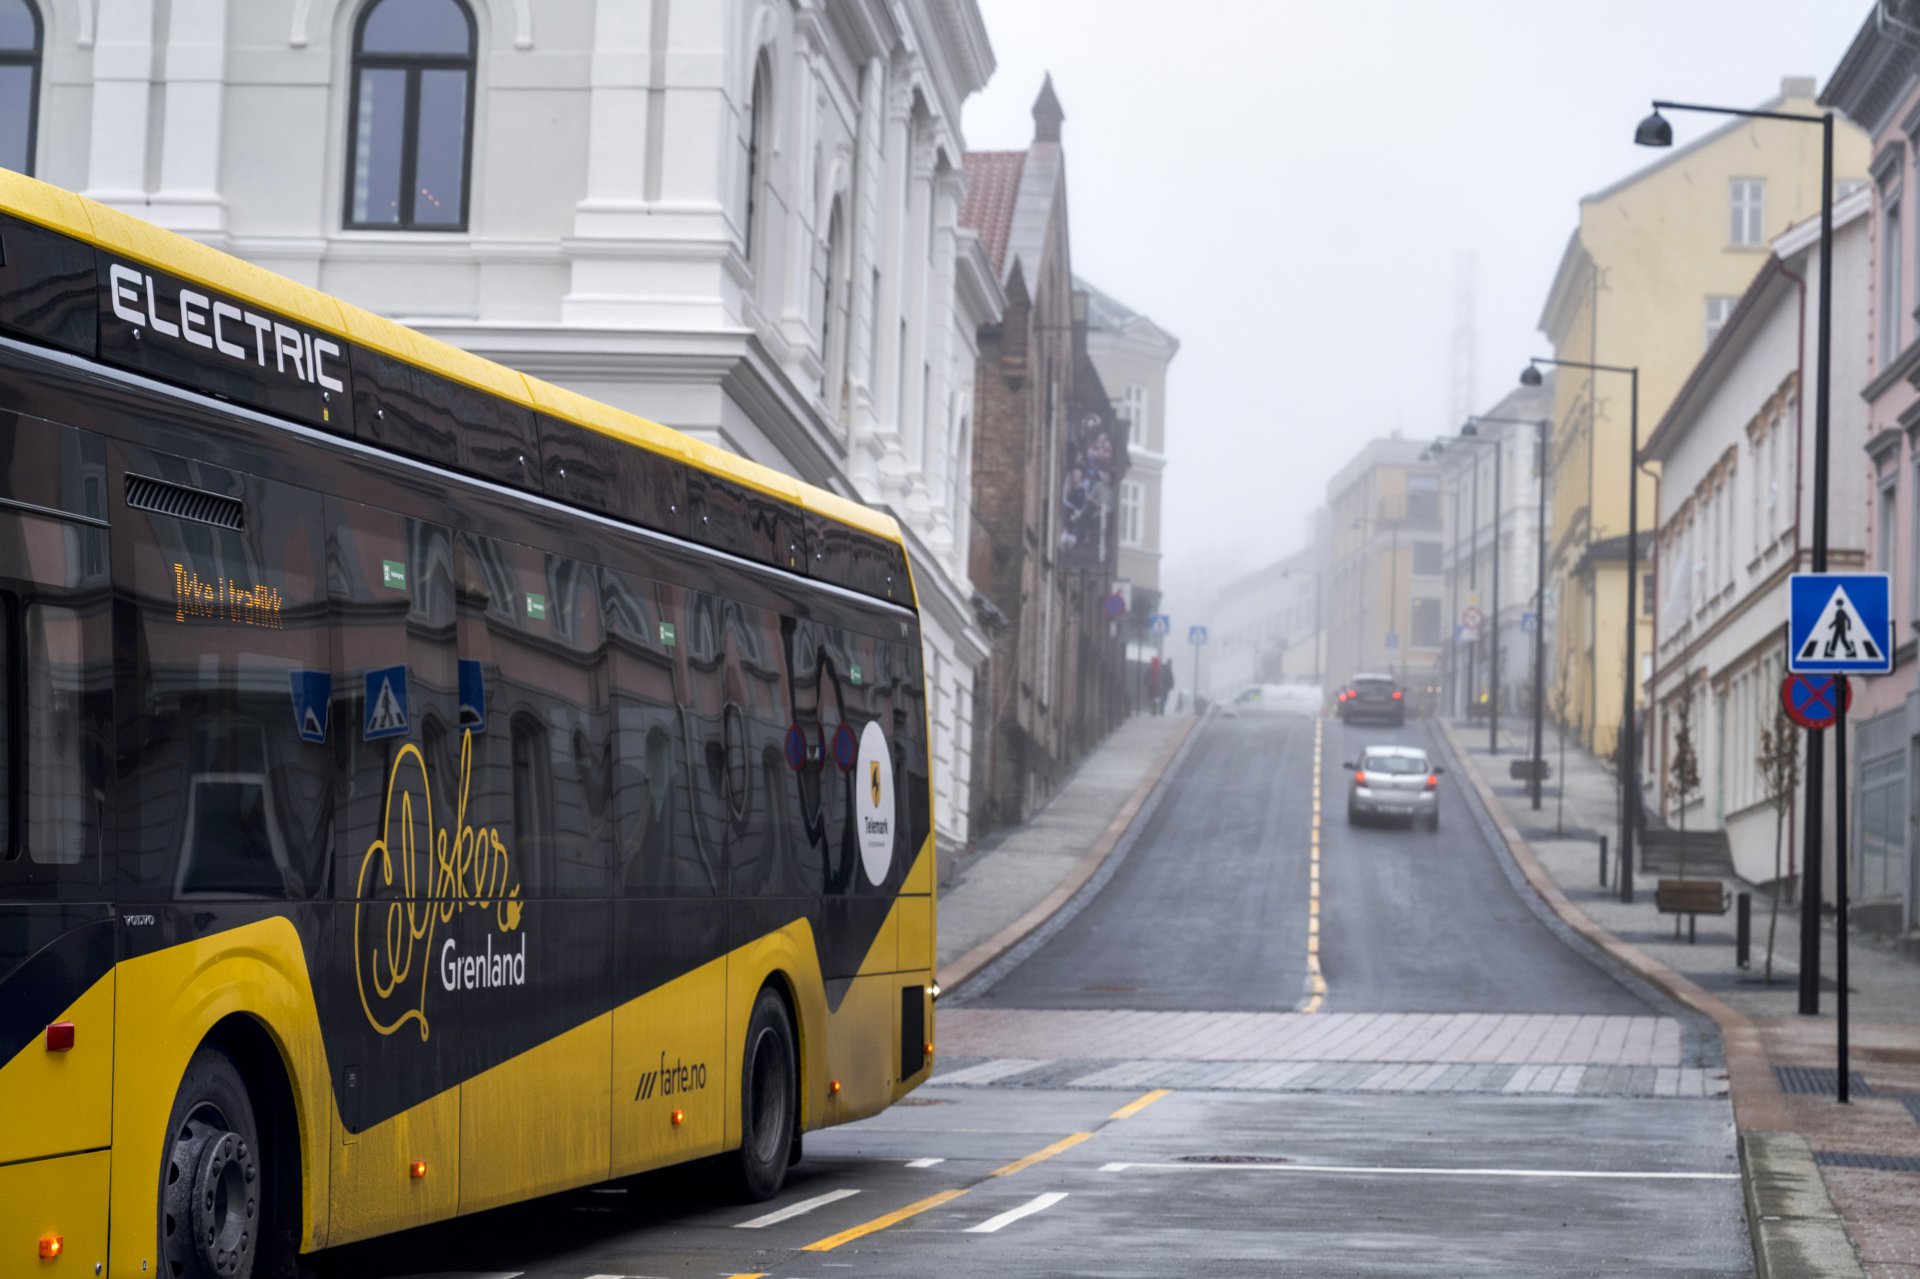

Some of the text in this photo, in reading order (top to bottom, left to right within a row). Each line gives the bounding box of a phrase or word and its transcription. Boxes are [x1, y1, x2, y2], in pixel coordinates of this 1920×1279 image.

[109, 263, 344, 393] ELECTRIC
[174, 563, 214, 622] Ikke
[228, 579, 283, 629] trafikk
[864, 816, 888, 835] Telemark
[122, 914, 155, 926] VOLVO
[441, 932, 525, 991] Grenland
[660, 1050, 706, 1096] farte.no
